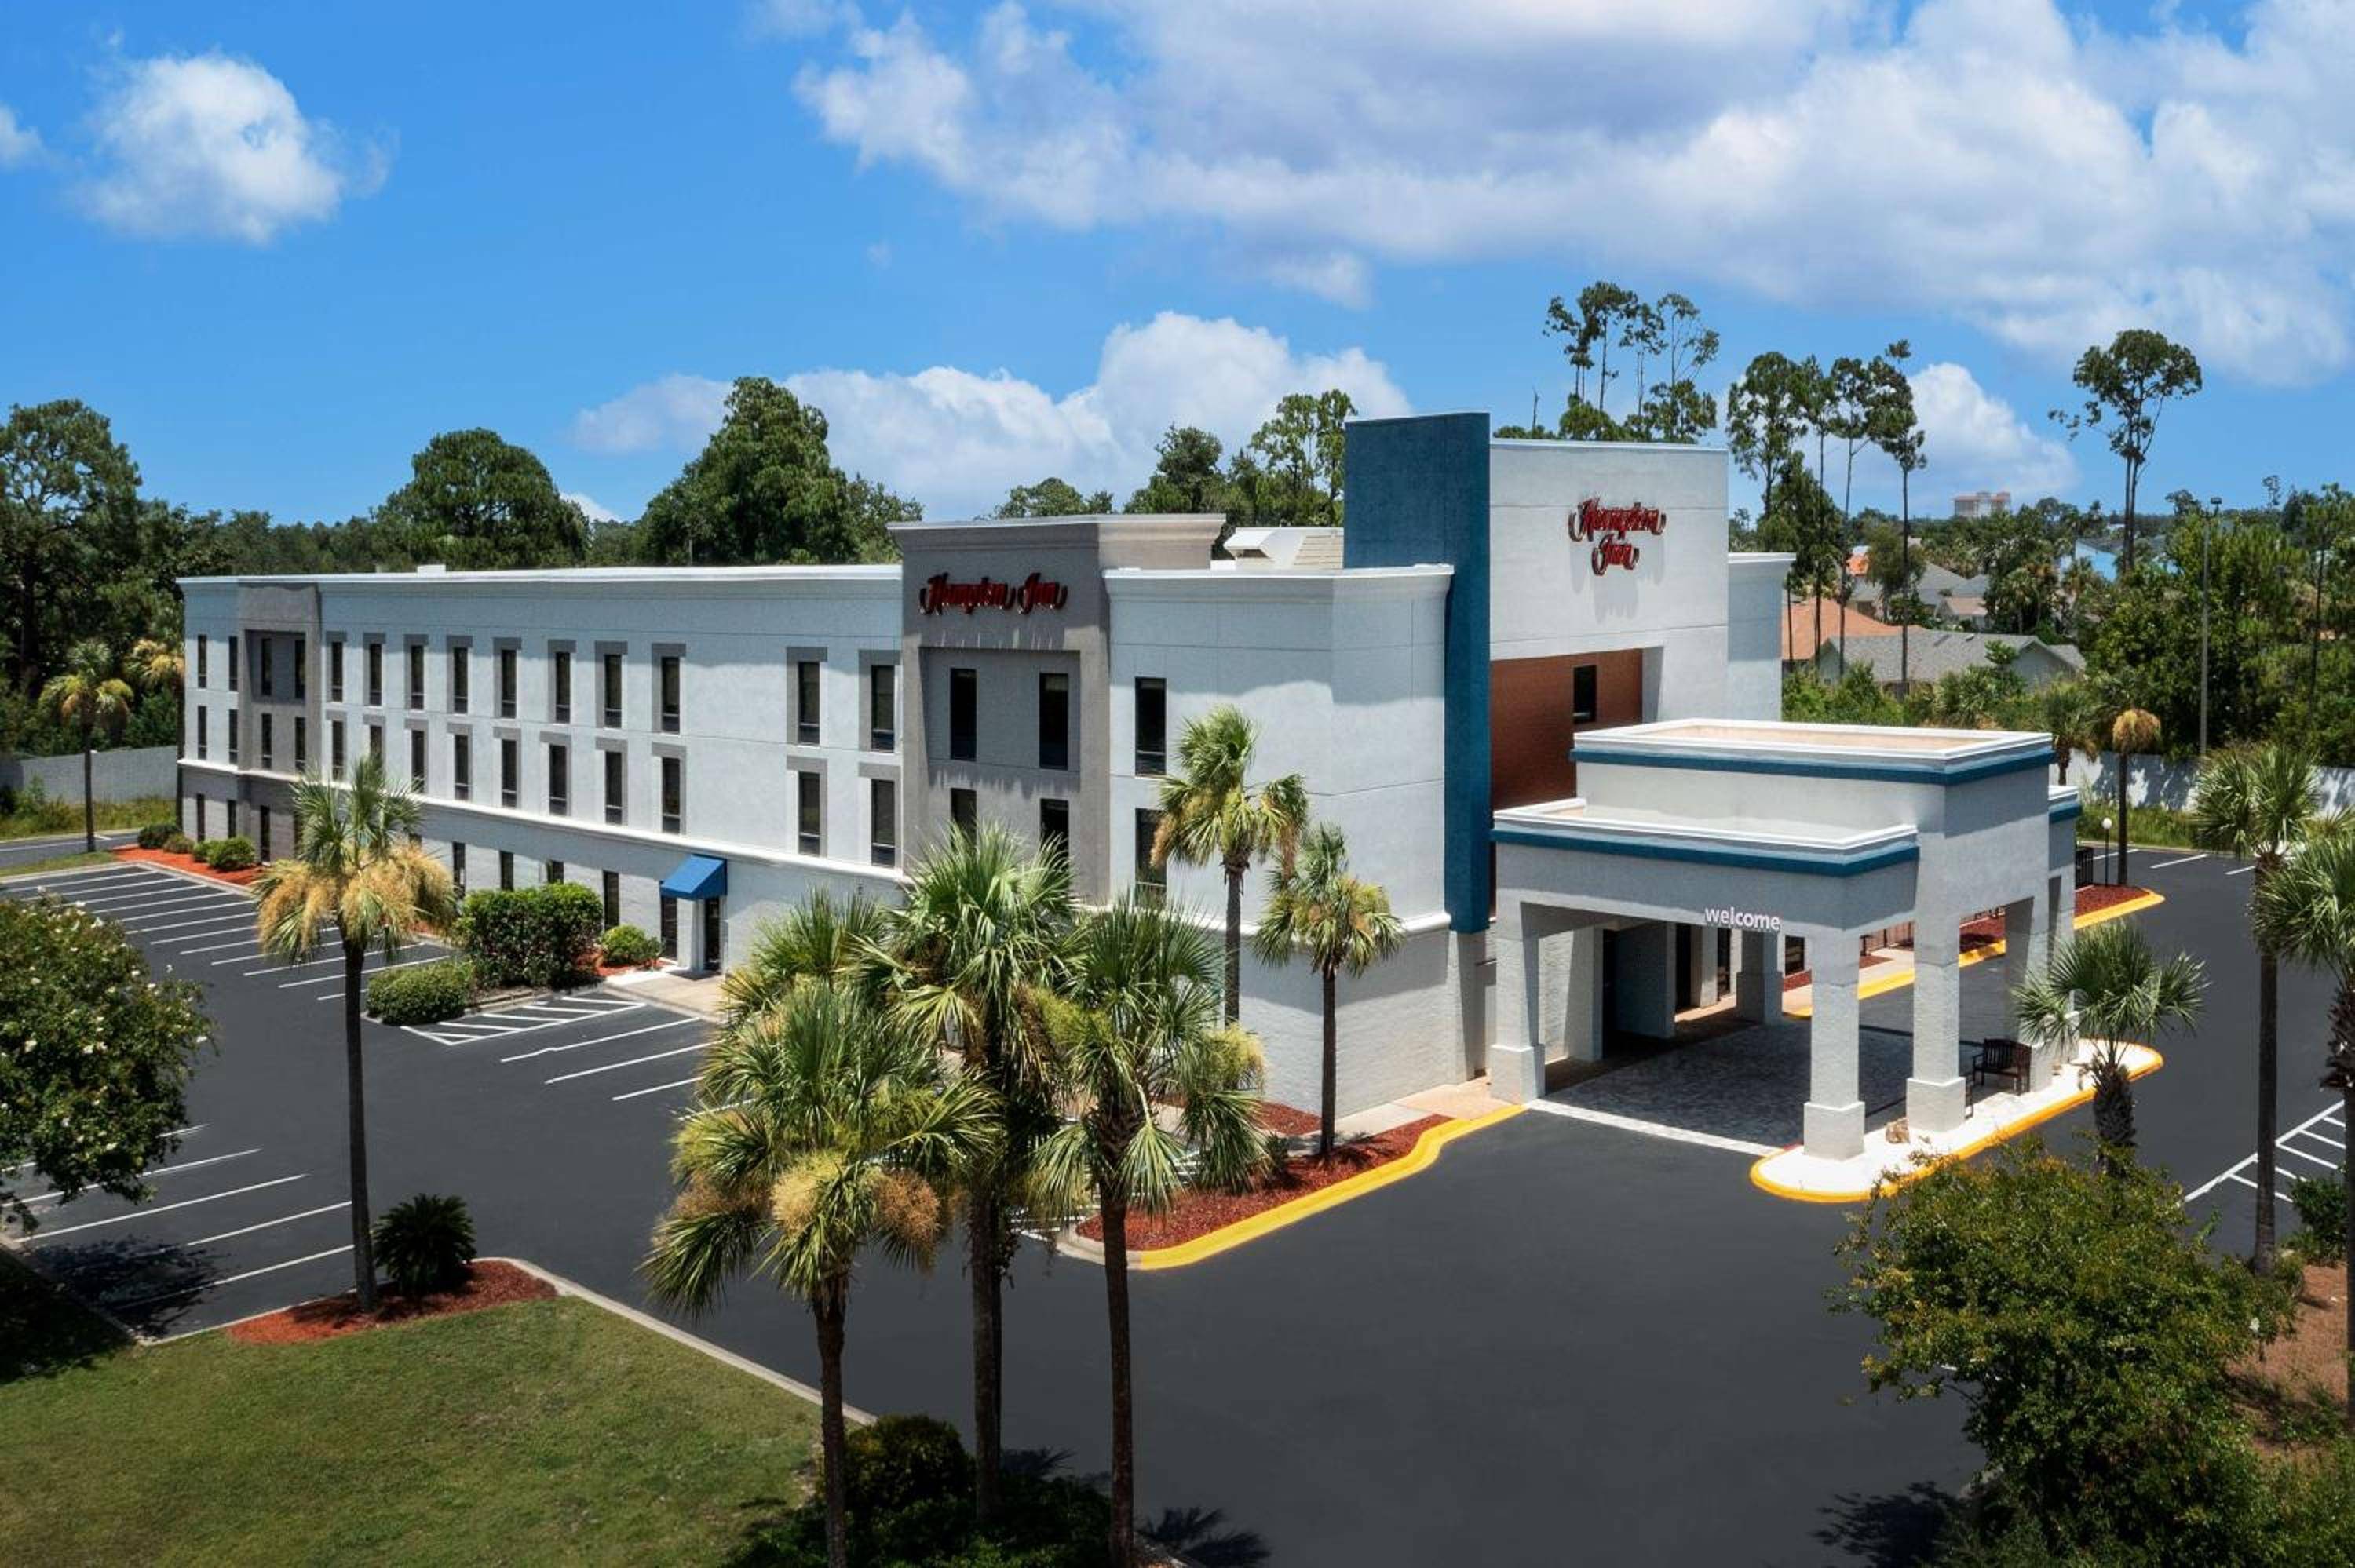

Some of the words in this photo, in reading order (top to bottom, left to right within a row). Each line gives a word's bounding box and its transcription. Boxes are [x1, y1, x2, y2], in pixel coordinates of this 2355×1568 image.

[1568, 497, 1667, 542] Hampton
[1591, 533, 1640, 576] Inn
[1704, 906, 1780, 931] welcome
